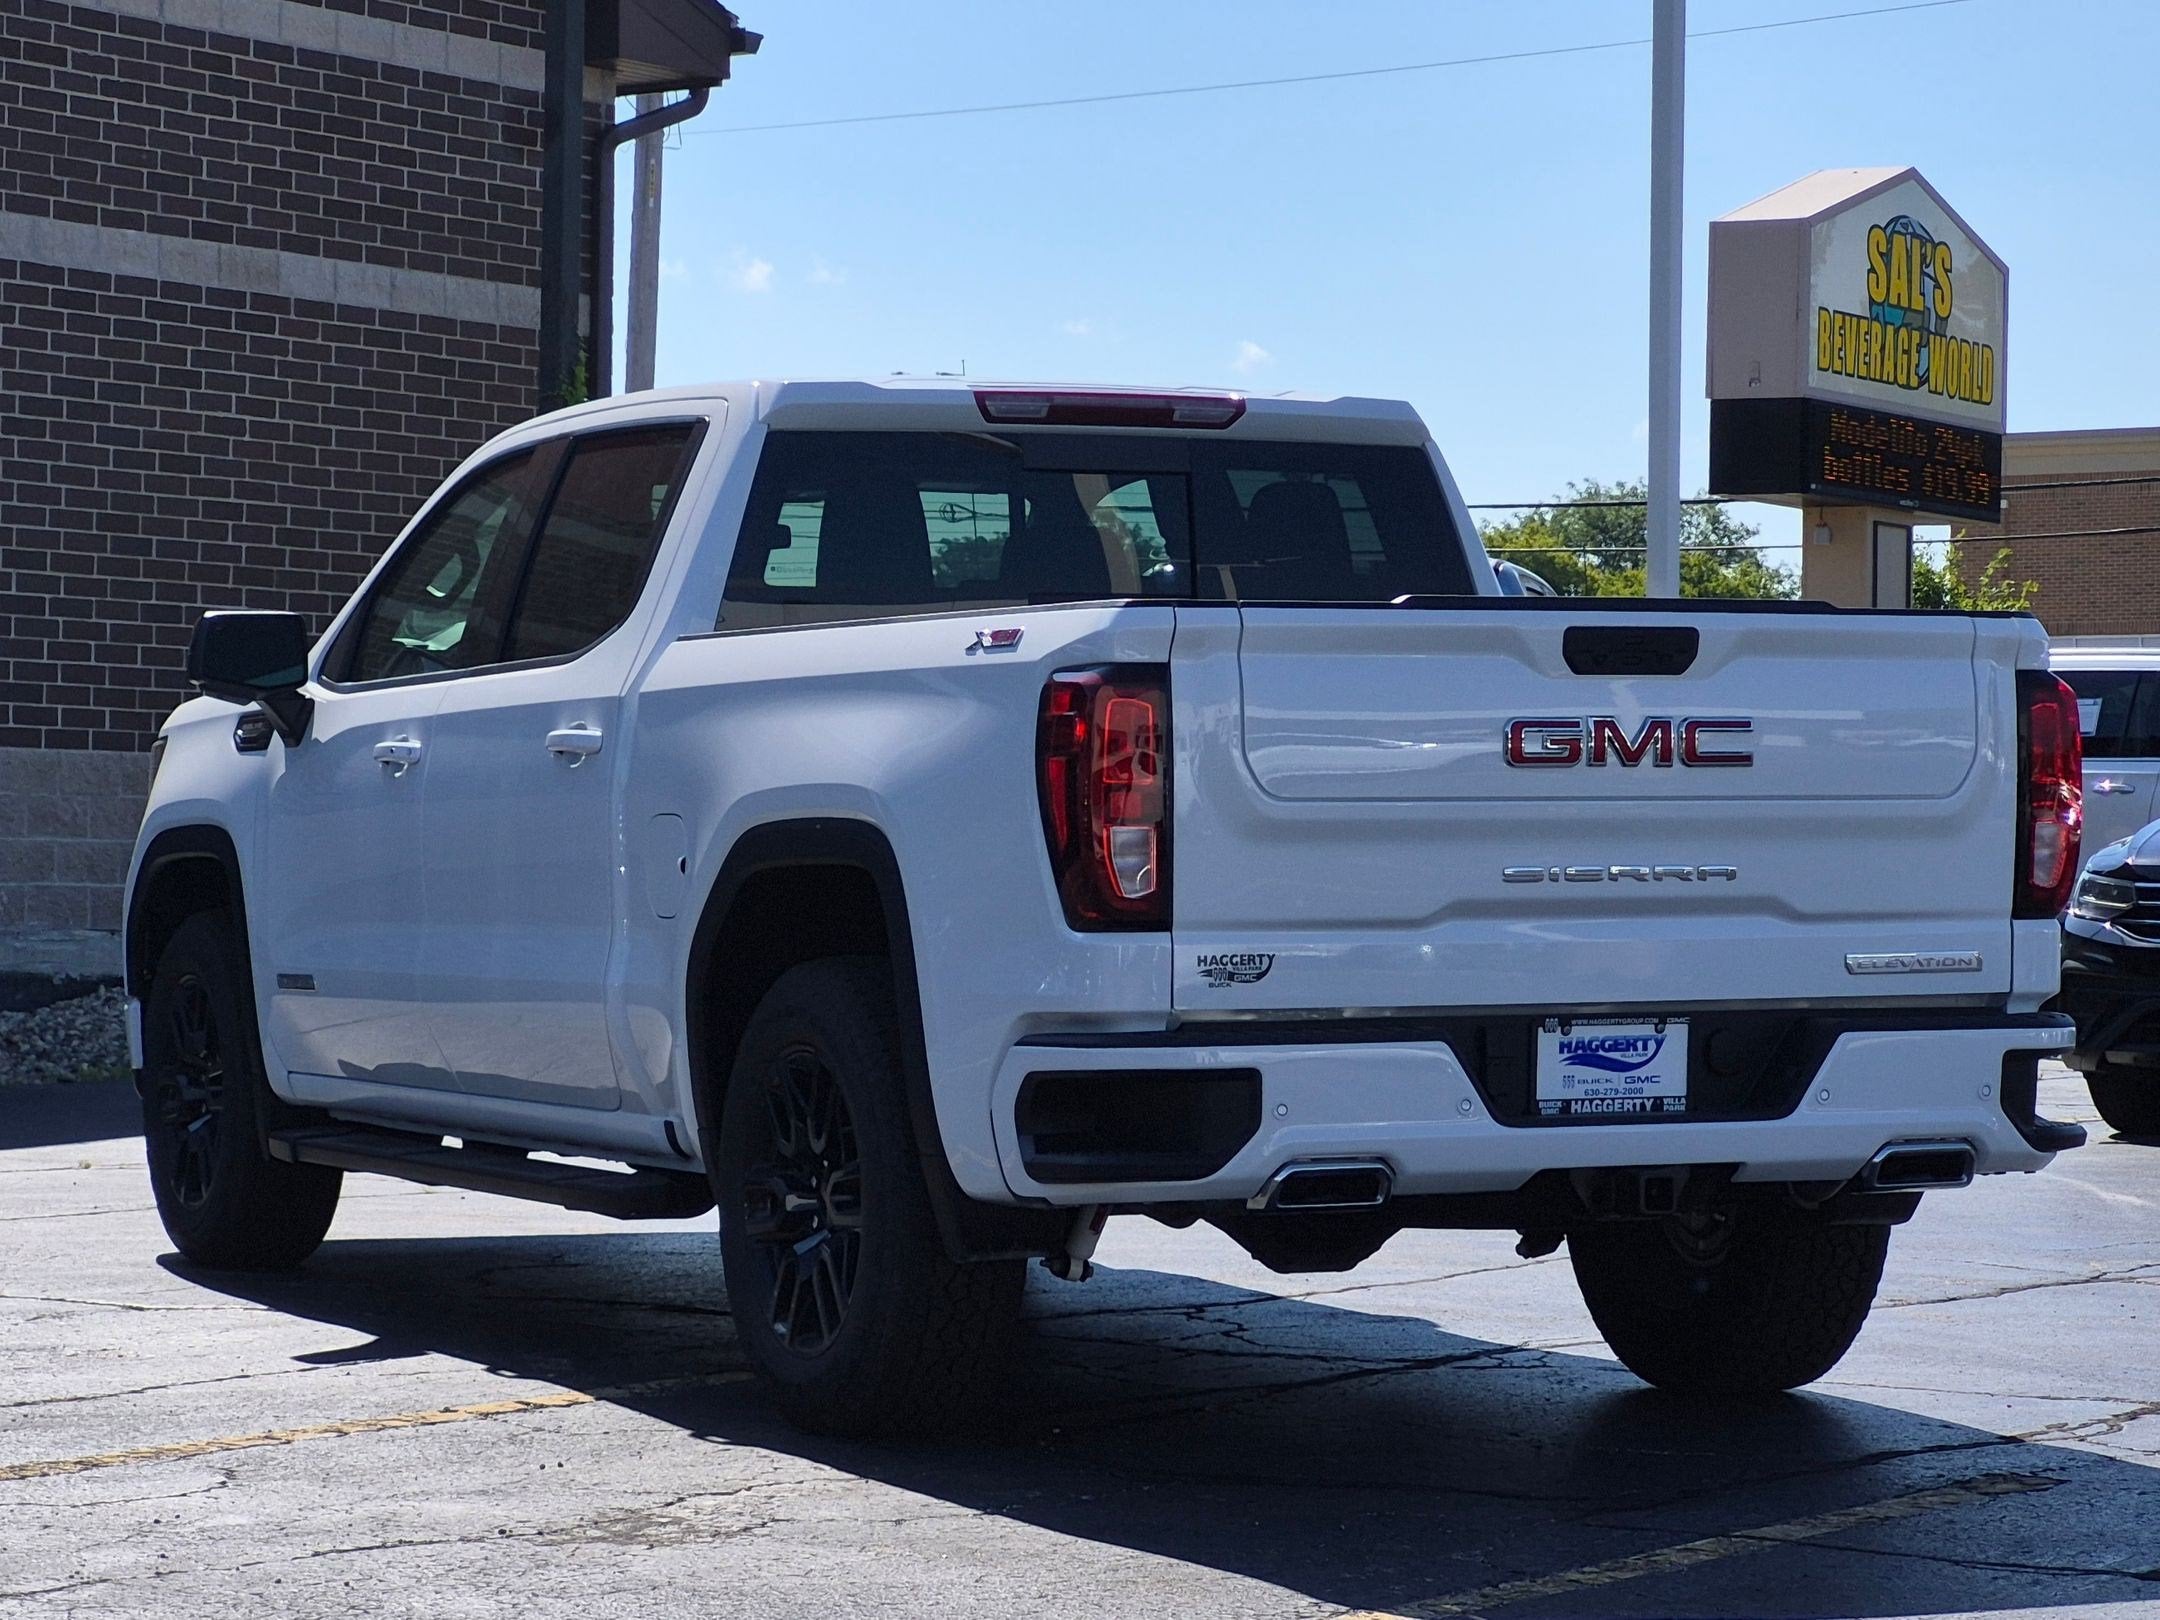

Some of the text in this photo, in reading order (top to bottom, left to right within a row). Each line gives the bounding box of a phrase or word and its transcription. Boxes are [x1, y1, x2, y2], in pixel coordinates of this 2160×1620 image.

[1867, 224, 1953, 319] SAL'S
[1817, 306, 1994, 406] BEVERAGE WORLD
[1823, 445, 1910, 491] bottles
[1503, 715, 1754, 768] GMC
[1502, 865, 1737, 883] SIERRA
[1197, 953, 1276, 968] HAGGERTY
[1857, 957, 1973, 970] ELEVATION
[1571, 1016, 1691, 1025] WWW.HAGGERTYGROUP.COM GMC
[1559, 1034, 1667, 1055] HAGGERTY
[1624, 1075, 1661, 1084] GMC
[1584, 1087, 1644, 1097] 630-279-2000
[1570, 1099, 1654, 1113] HAGGERTY
[1663, 1097, 1687, 1105] VILLA
[1663, 1104, 1686, 1112] PARK
